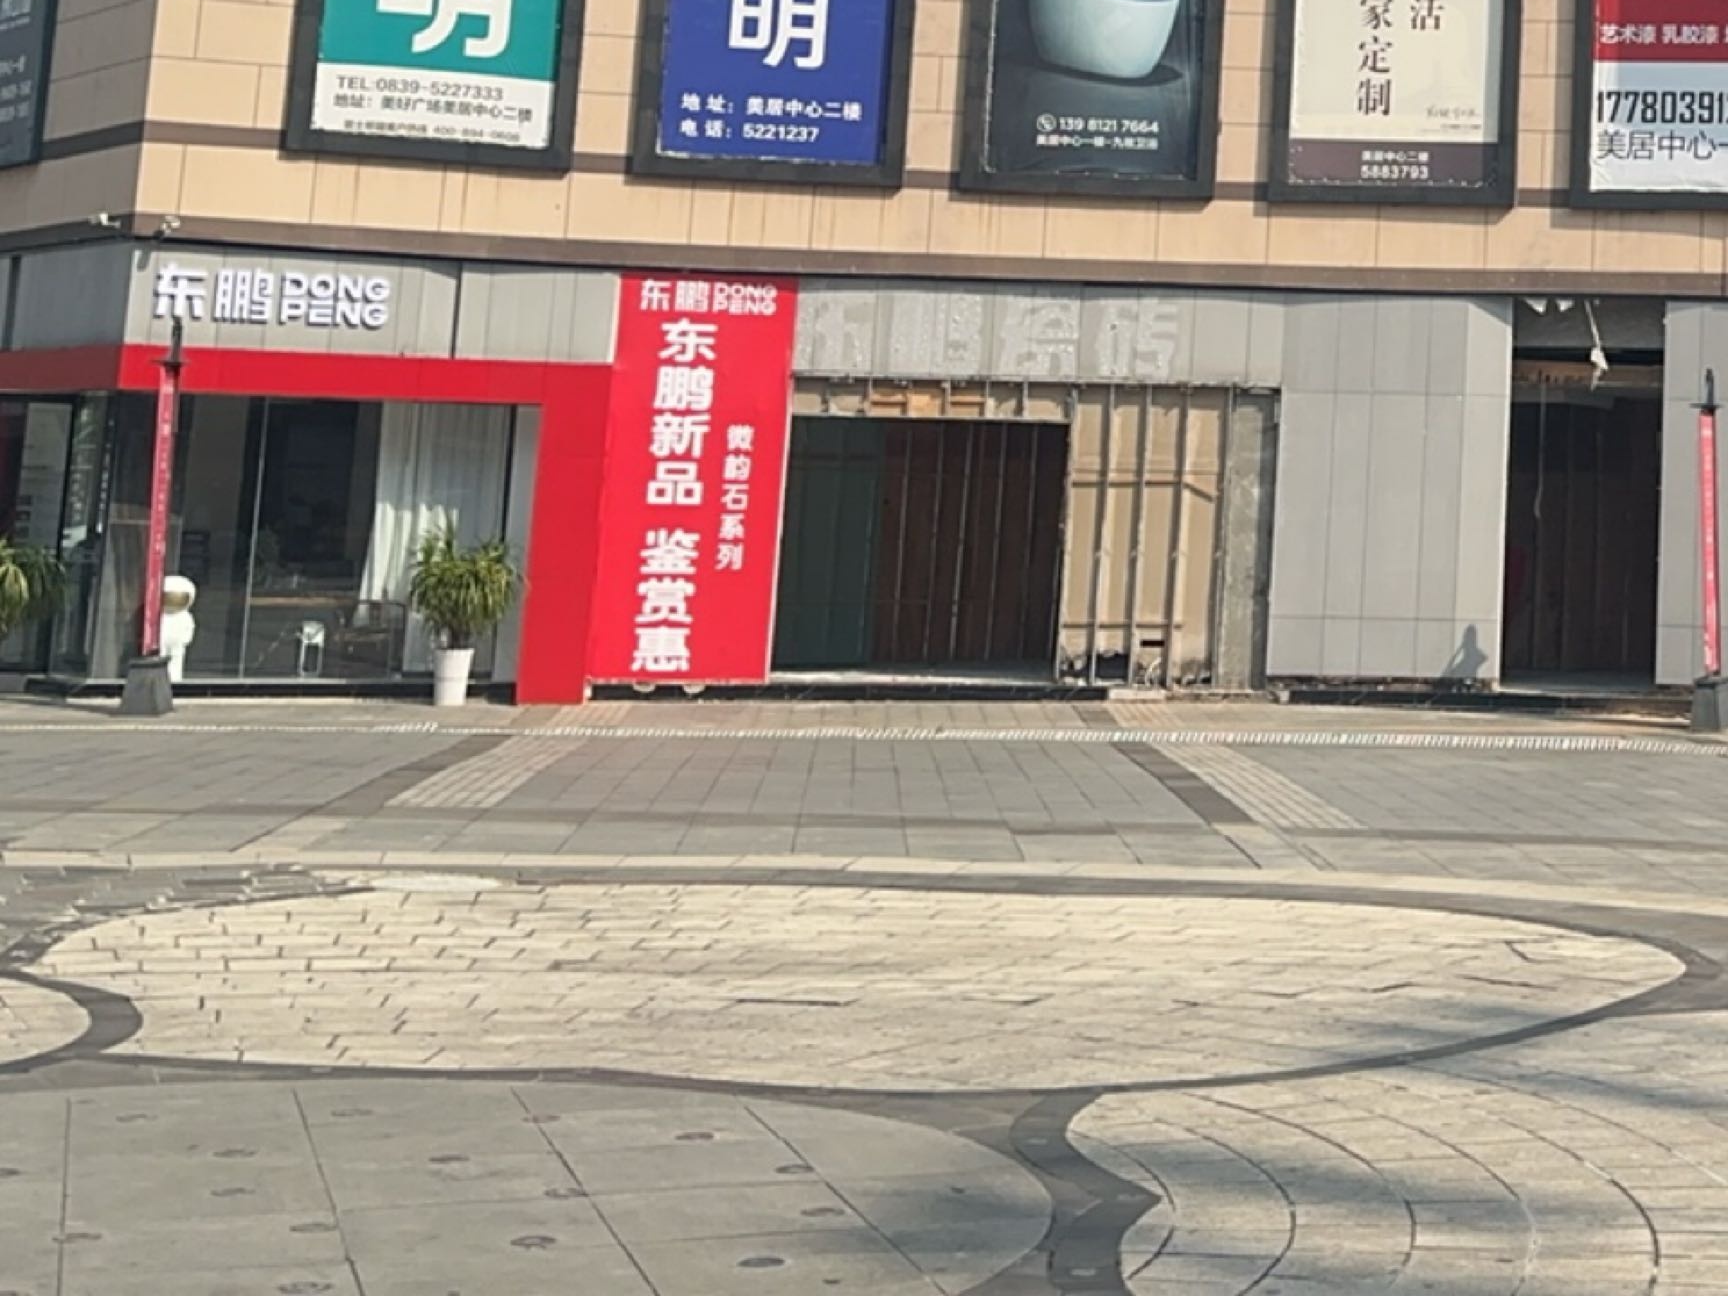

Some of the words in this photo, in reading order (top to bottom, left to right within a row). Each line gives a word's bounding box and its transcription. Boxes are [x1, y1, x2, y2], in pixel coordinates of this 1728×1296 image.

[1662, 23, 1719, 45] 乳胶漆
[154, 262, 274, 325] 东鹏
[280, 271, 391, 301] DONG
[640, 279, 711, 313] 东鹏
[712, 297, 777, 316] PENG
[279, 299, 389, 330] PENG
[646, 317, 718, 506] 东鹏新品
[631, 528, 701, 673] 鉴赏惠
